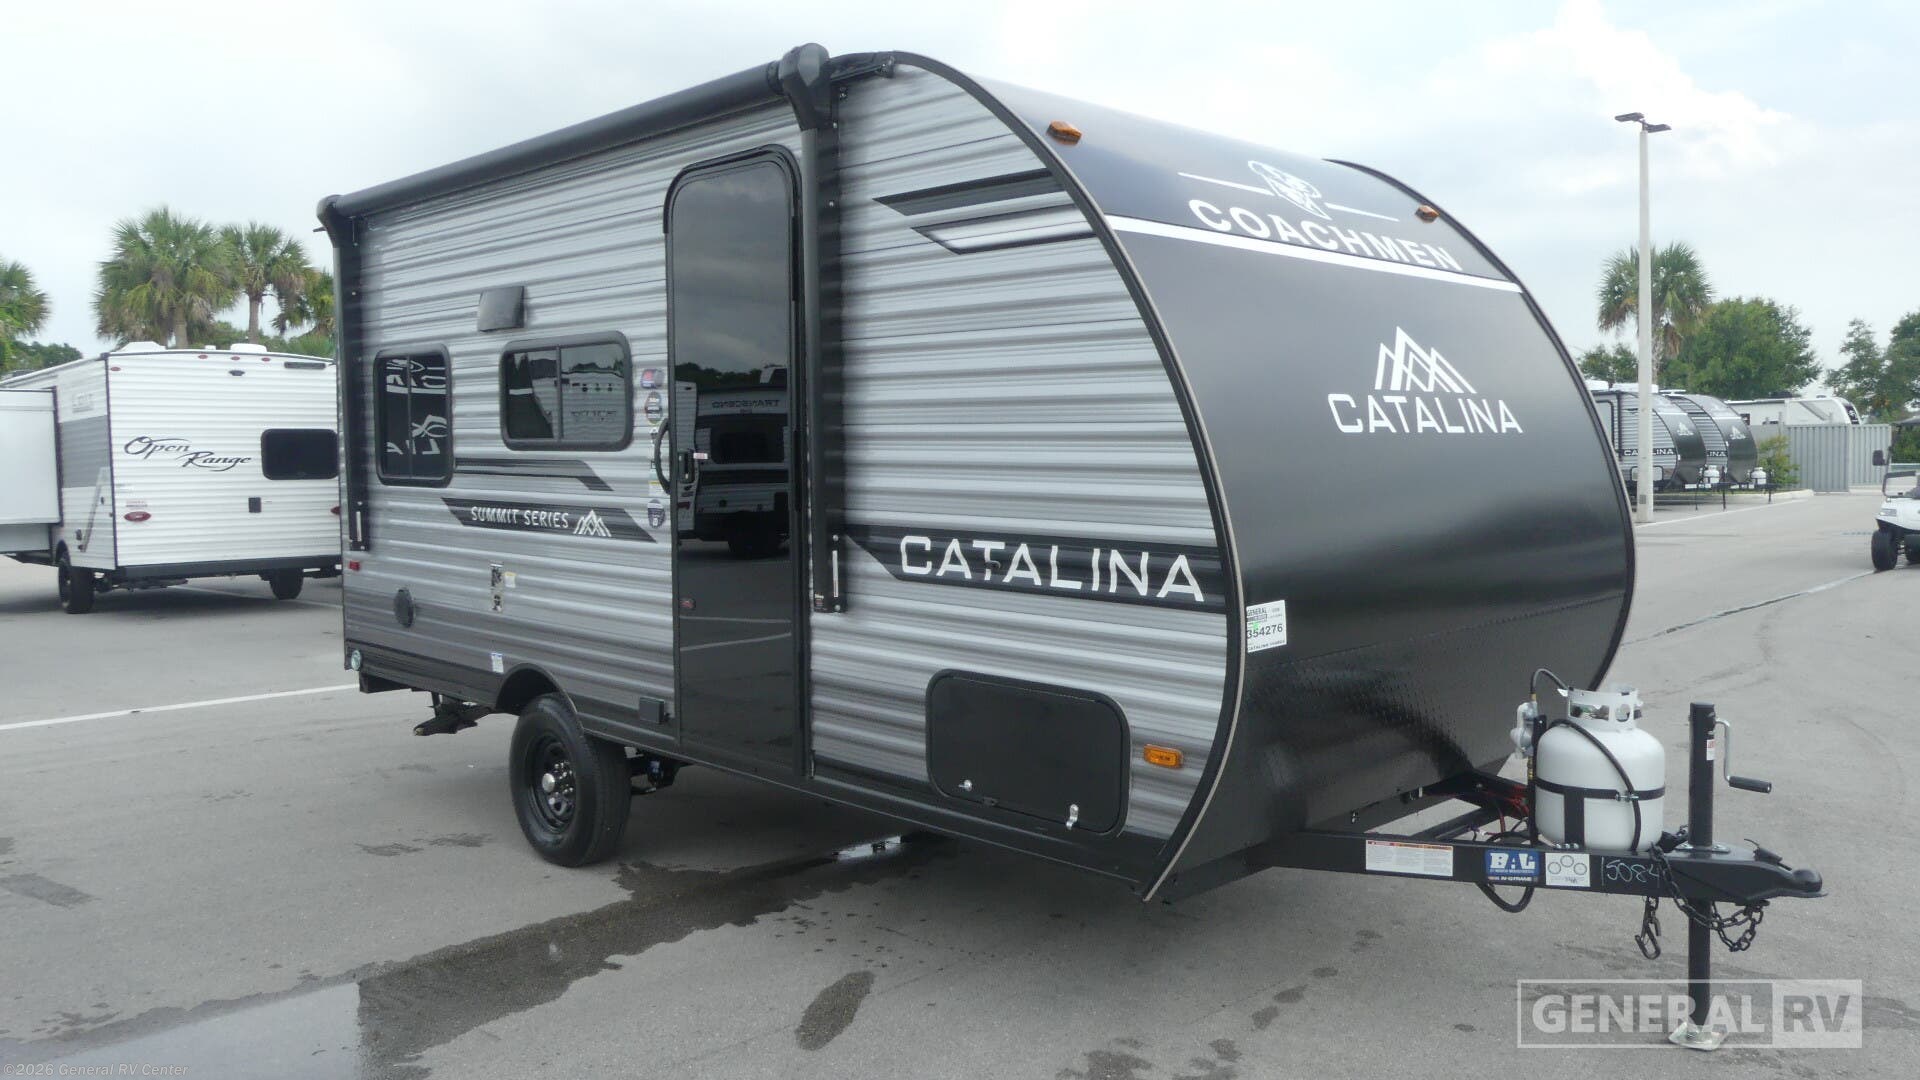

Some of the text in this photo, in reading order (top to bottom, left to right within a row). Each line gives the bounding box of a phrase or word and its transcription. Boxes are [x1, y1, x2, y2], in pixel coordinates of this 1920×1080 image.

[1188, 199, 1463, 271] COACHMEN
[1328, 393, 1523, 434] CATALINA
[124, 436, 191, 459] Open
[175, 451, 252, 472] Range
[471, 506, 569, 529] SUMMIT SERIES
[900, 535, 1204, 602] CATALINA
[1246, 623, 1284, 640] 354276
